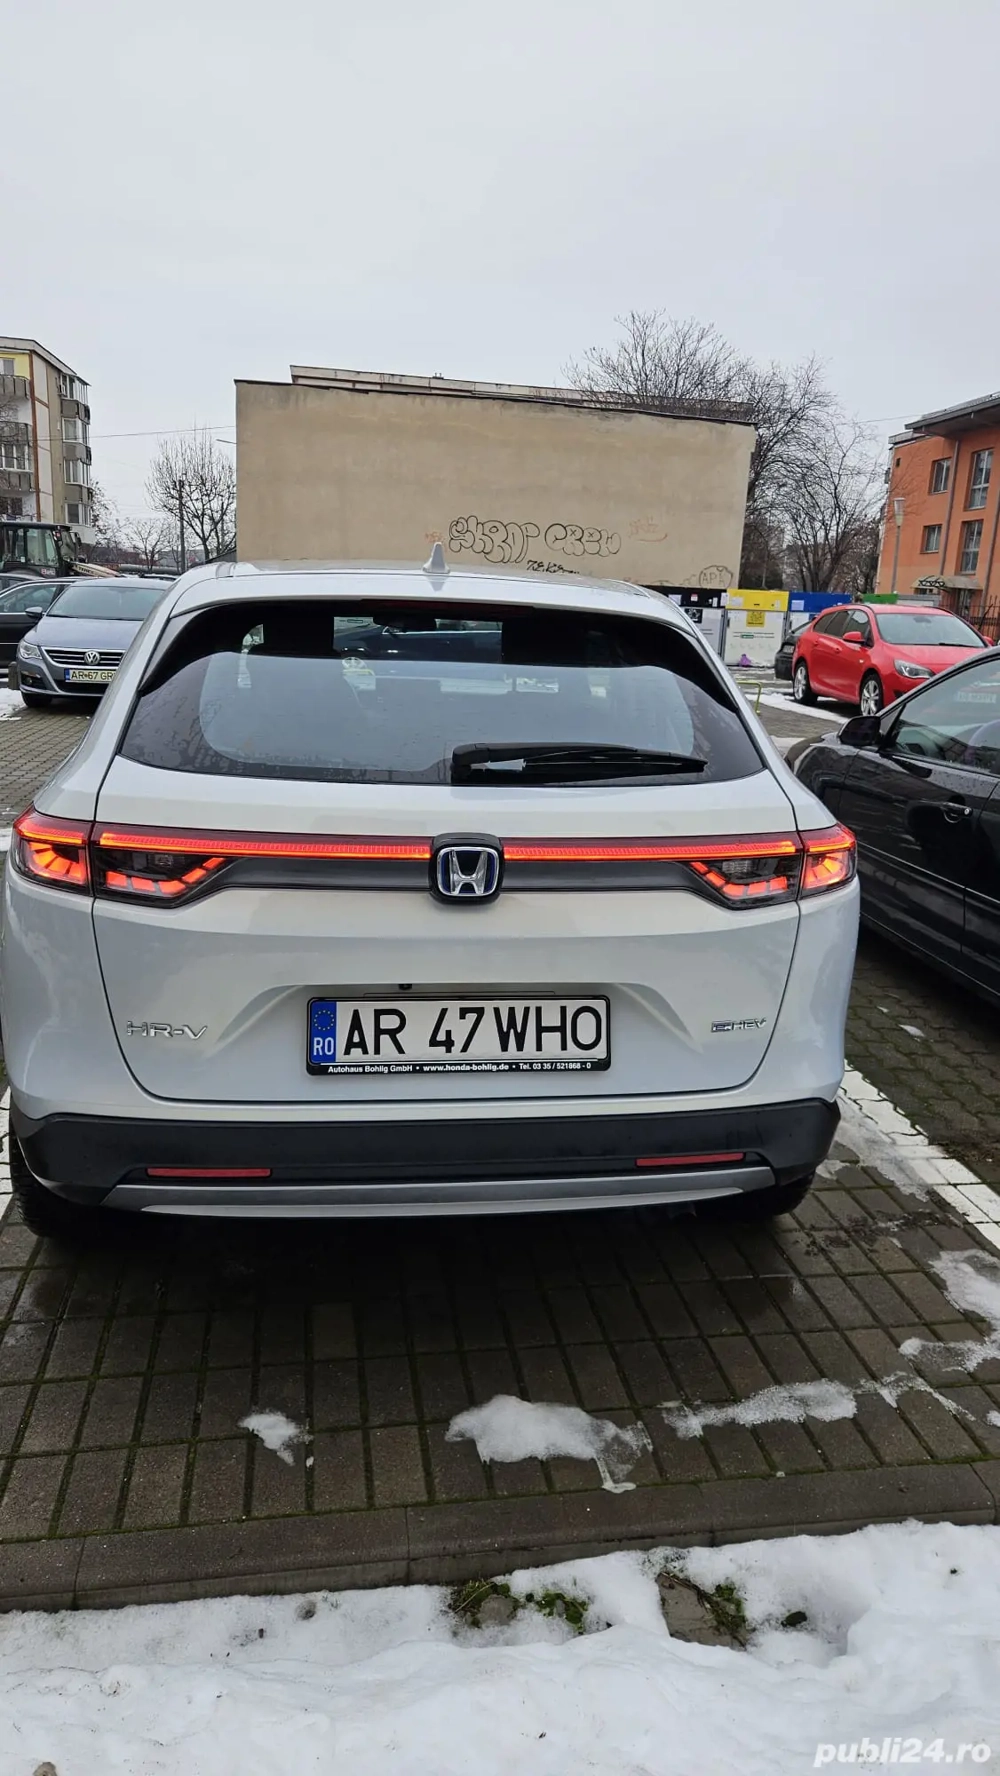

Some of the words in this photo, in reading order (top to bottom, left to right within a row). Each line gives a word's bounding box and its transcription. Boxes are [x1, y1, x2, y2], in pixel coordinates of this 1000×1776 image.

[71, 670, 85, 679] AR
[126, 1020, 208, 1040] HR-V
[343, 1008, 407, 1056] AR
[312, 1036, 334, 1056] RO
[364, 1065, 389, 1074] Bohlig
[423, 1063, 509, 1072] www.honda-bohlig.de
